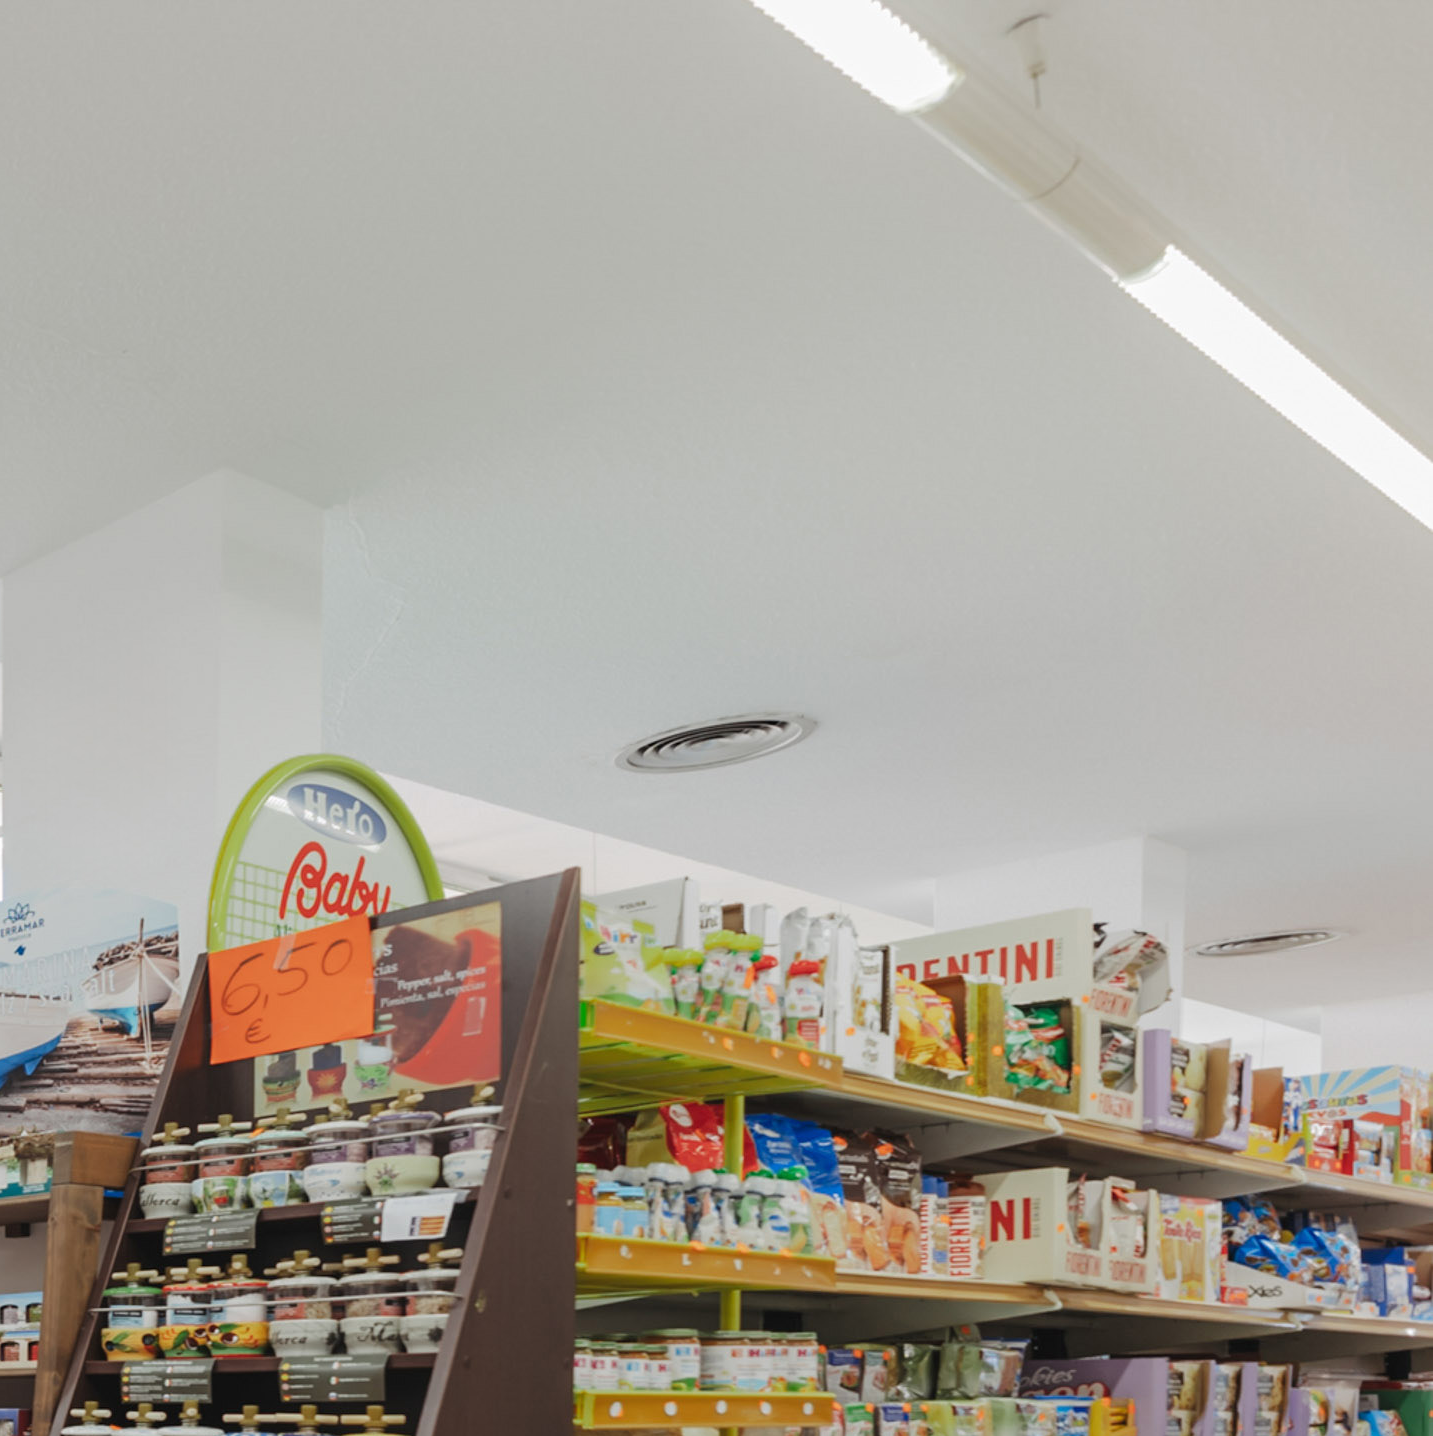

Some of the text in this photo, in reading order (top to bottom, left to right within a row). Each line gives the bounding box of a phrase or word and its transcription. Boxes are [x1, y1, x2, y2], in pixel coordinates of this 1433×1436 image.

[303, 787, 375, 840] Hero
[279, 841, 390, 920] Baby
[221, 938, 354, 1017] 6,50
[245, 1018, 271, 1044] €
